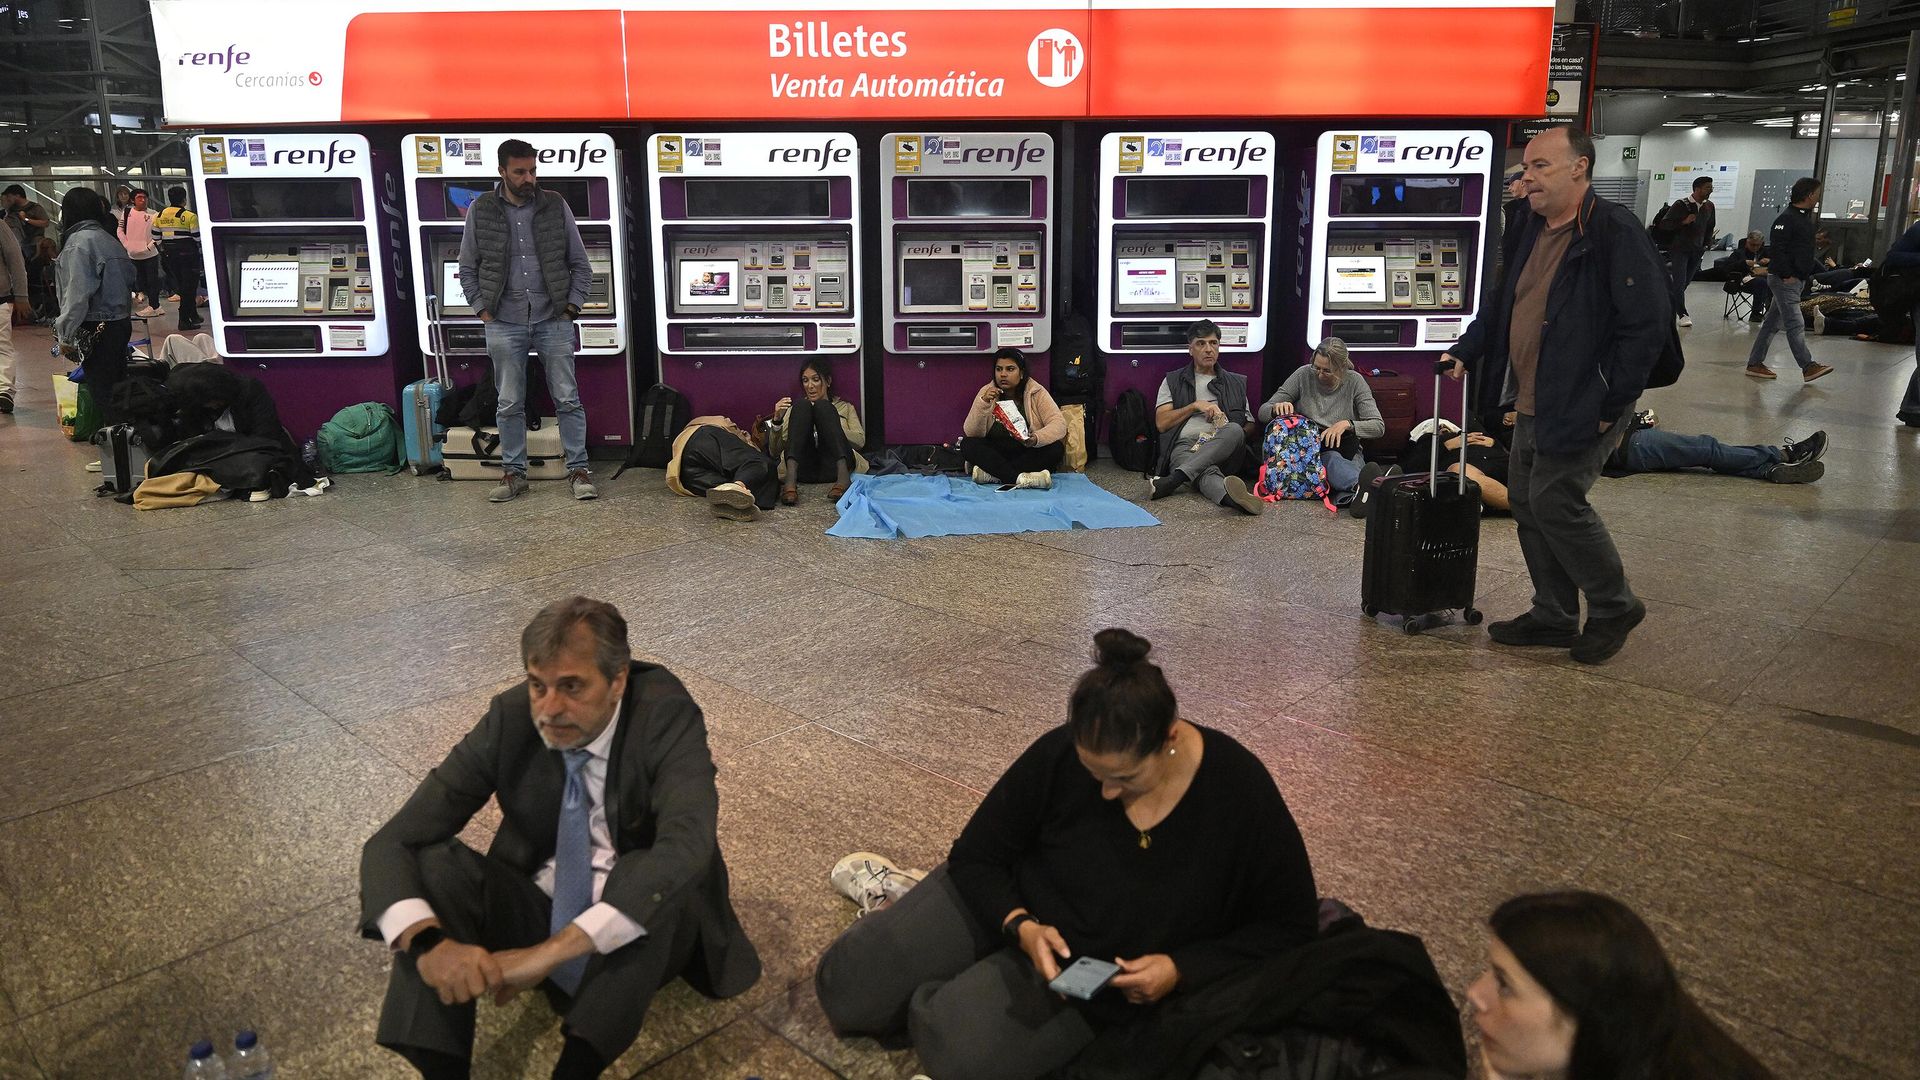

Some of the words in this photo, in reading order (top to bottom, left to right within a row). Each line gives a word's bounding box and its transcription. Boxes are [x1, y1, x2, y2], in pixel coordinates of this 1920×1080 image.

[770, 22, 908, 58] Billetes
[179, 44, 251, 74] renfe
[234, 71, 305, 88] Cercanías
[771, 73, 845, 98] Venta
[849, 70, 1005, 98] Automática
[274, 140, 356, 173] renfe
[536, 139, 607, 173] enfe
[768, 139, 851, 171] renfe
[962, 139, 1045, 171] renfe
[1184, 138, 1267, 170] renfe
[1402, 135, 1484, 168] renfe
[380, 170, 407, 300] renfe
[683, 243, 718, 257] renfe
[907, 243, 942, 257] renfe
[1121, 241, 1156, 256] renfe
